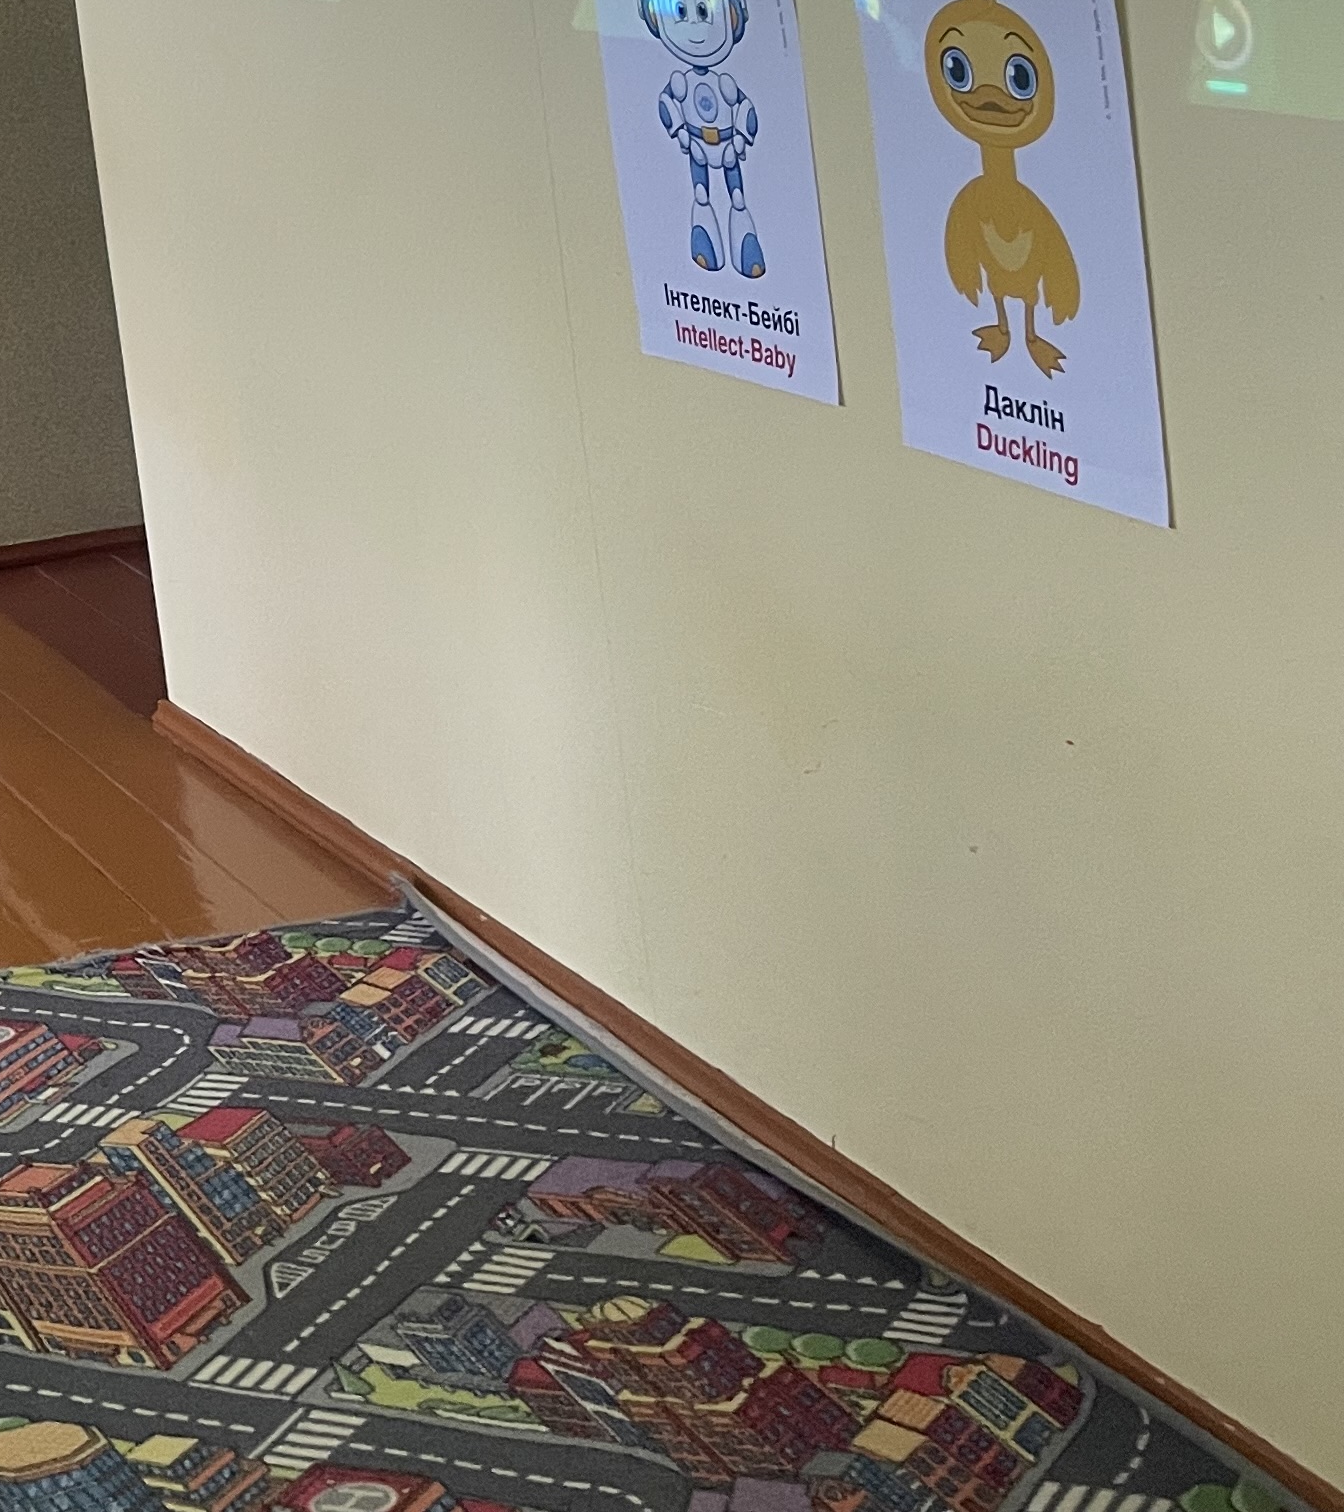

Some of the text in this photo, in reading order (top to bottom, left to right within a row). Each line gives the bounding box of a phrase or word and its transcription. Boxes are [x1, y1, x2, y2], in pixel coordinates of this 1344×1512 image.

[663, 282, 800, 337] Інтелект-Бейбі
[674, 319, 796, 378] Intellect-Baby
[983, 384, 1065, 432] Даклін
[976, 422, 1078, 486] Duckling
